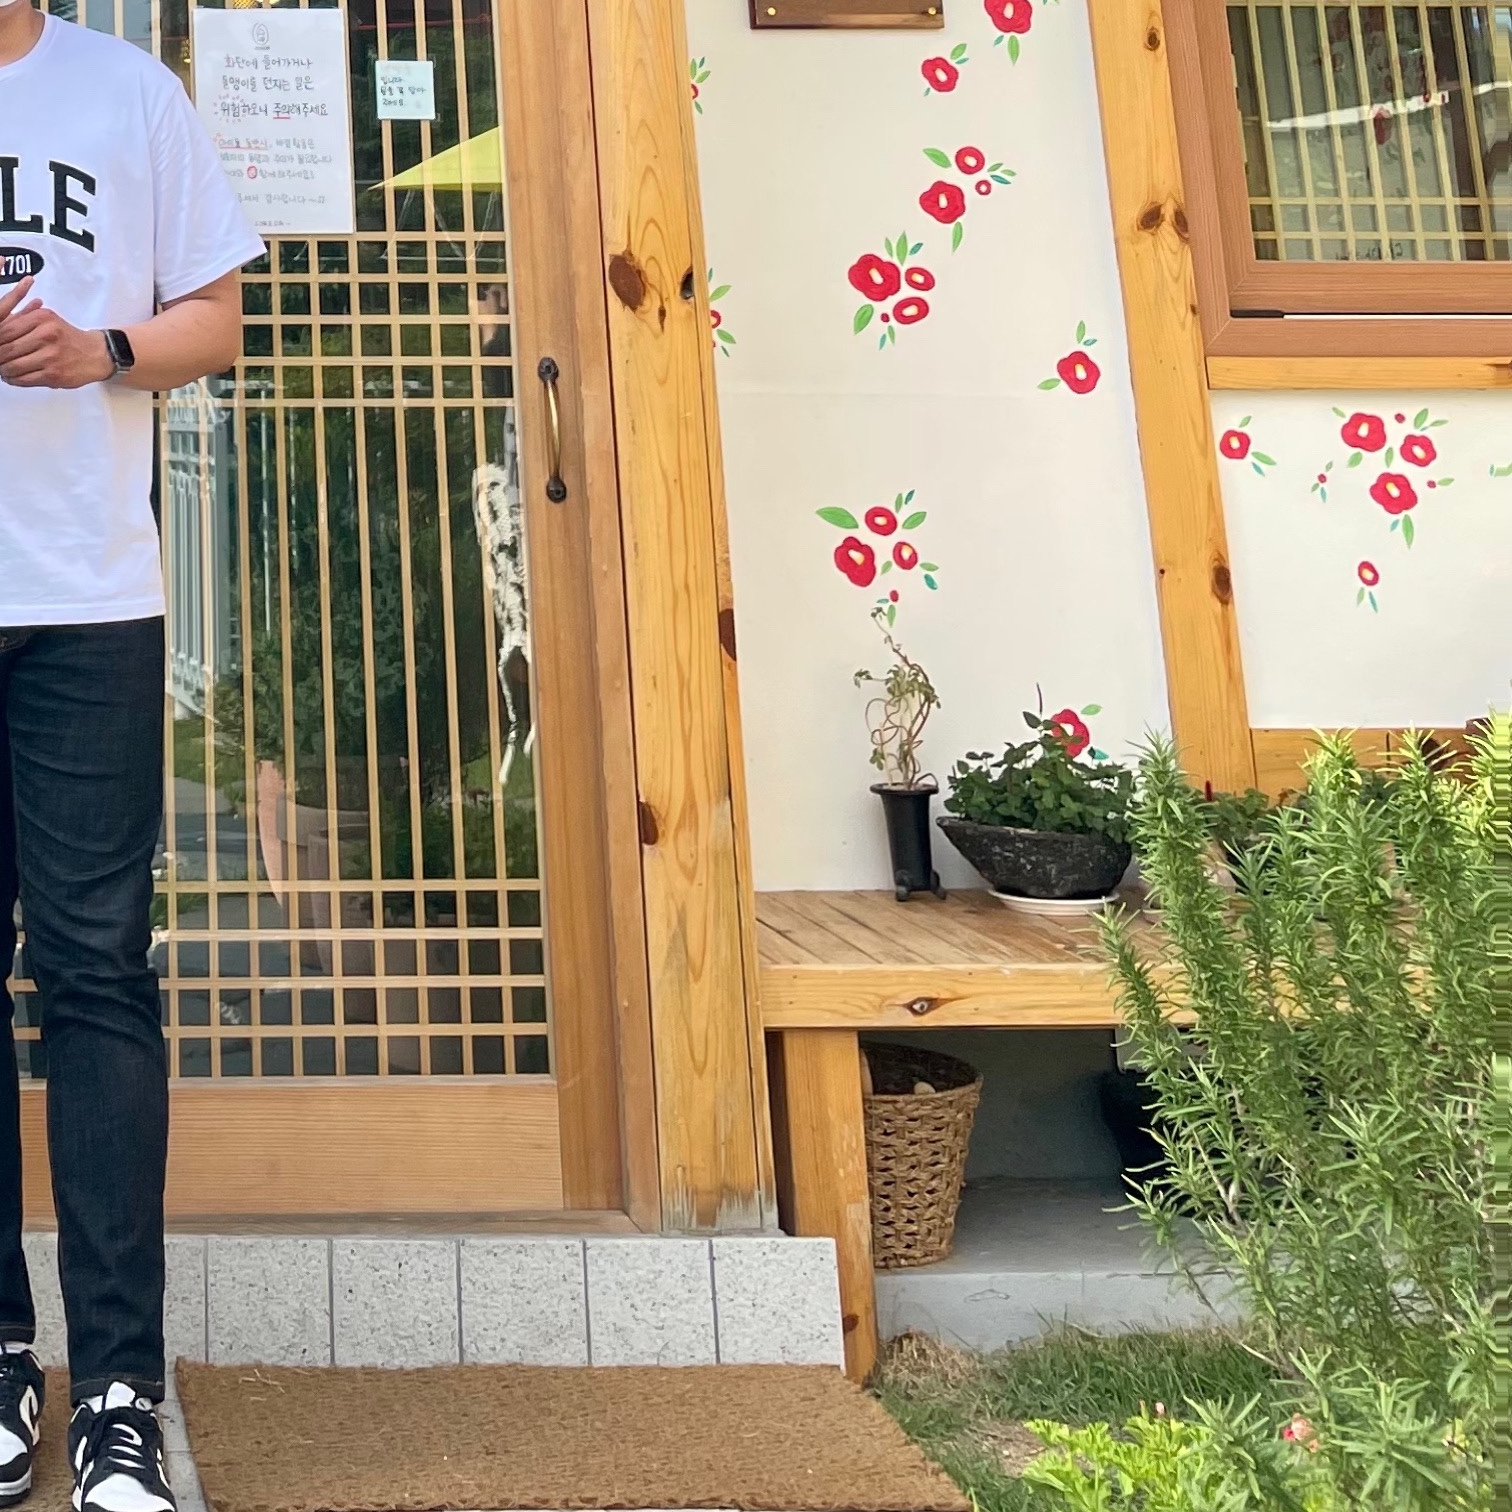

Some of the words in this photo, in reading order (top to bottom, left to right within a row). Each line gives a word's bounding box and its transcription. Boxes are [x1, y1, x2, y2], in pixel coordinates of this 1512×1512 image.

[224, 54, 258, 69] 화단에
[263, 54, 313, 70] 들어가거나
[263, 76, 291, 92] 던지는
